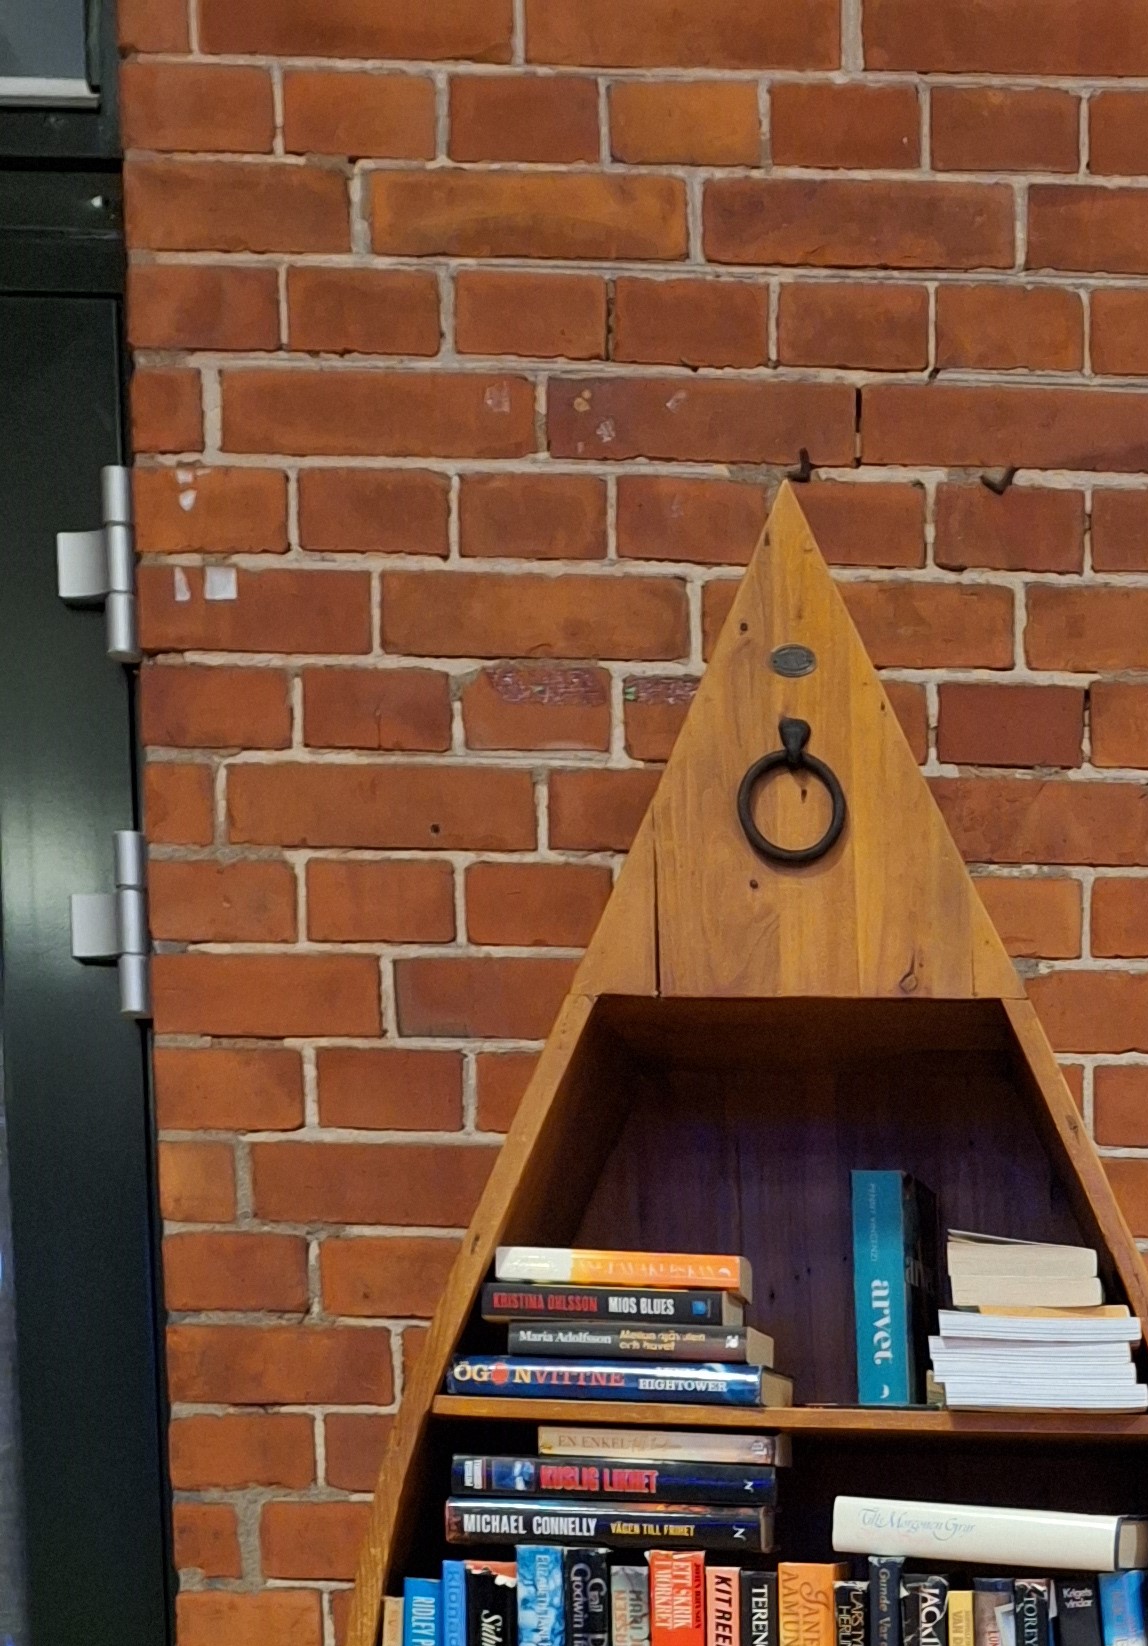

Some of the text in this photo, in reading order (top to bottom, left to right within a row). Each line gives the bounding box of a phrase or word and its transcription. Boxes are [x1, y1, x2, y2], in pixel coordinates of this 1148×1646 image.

[493, 1292, 597, 1312] KRISTINA OHLSSON
[608, 1297, 675, 1316] MIOS BLUES
[871, 1279, 893, 1365] arvet
[519, 1331, 553, 1343] Maria
[638, 1378, 727, 1392] HIGHTOWER
[463, 1515, 526, 1535] MICHAEL
[532, 1516, 597, 1536] CONNELLY
[570, 1562, 590, 1628] Godwin
[673, 1561, 692, 1629] ETT SKRIK
[714, 1575, 732, 1603] KIT
[412, 1596, 435, 1635] RIDLEY
[850, 1589, 863, 1626] LARS
